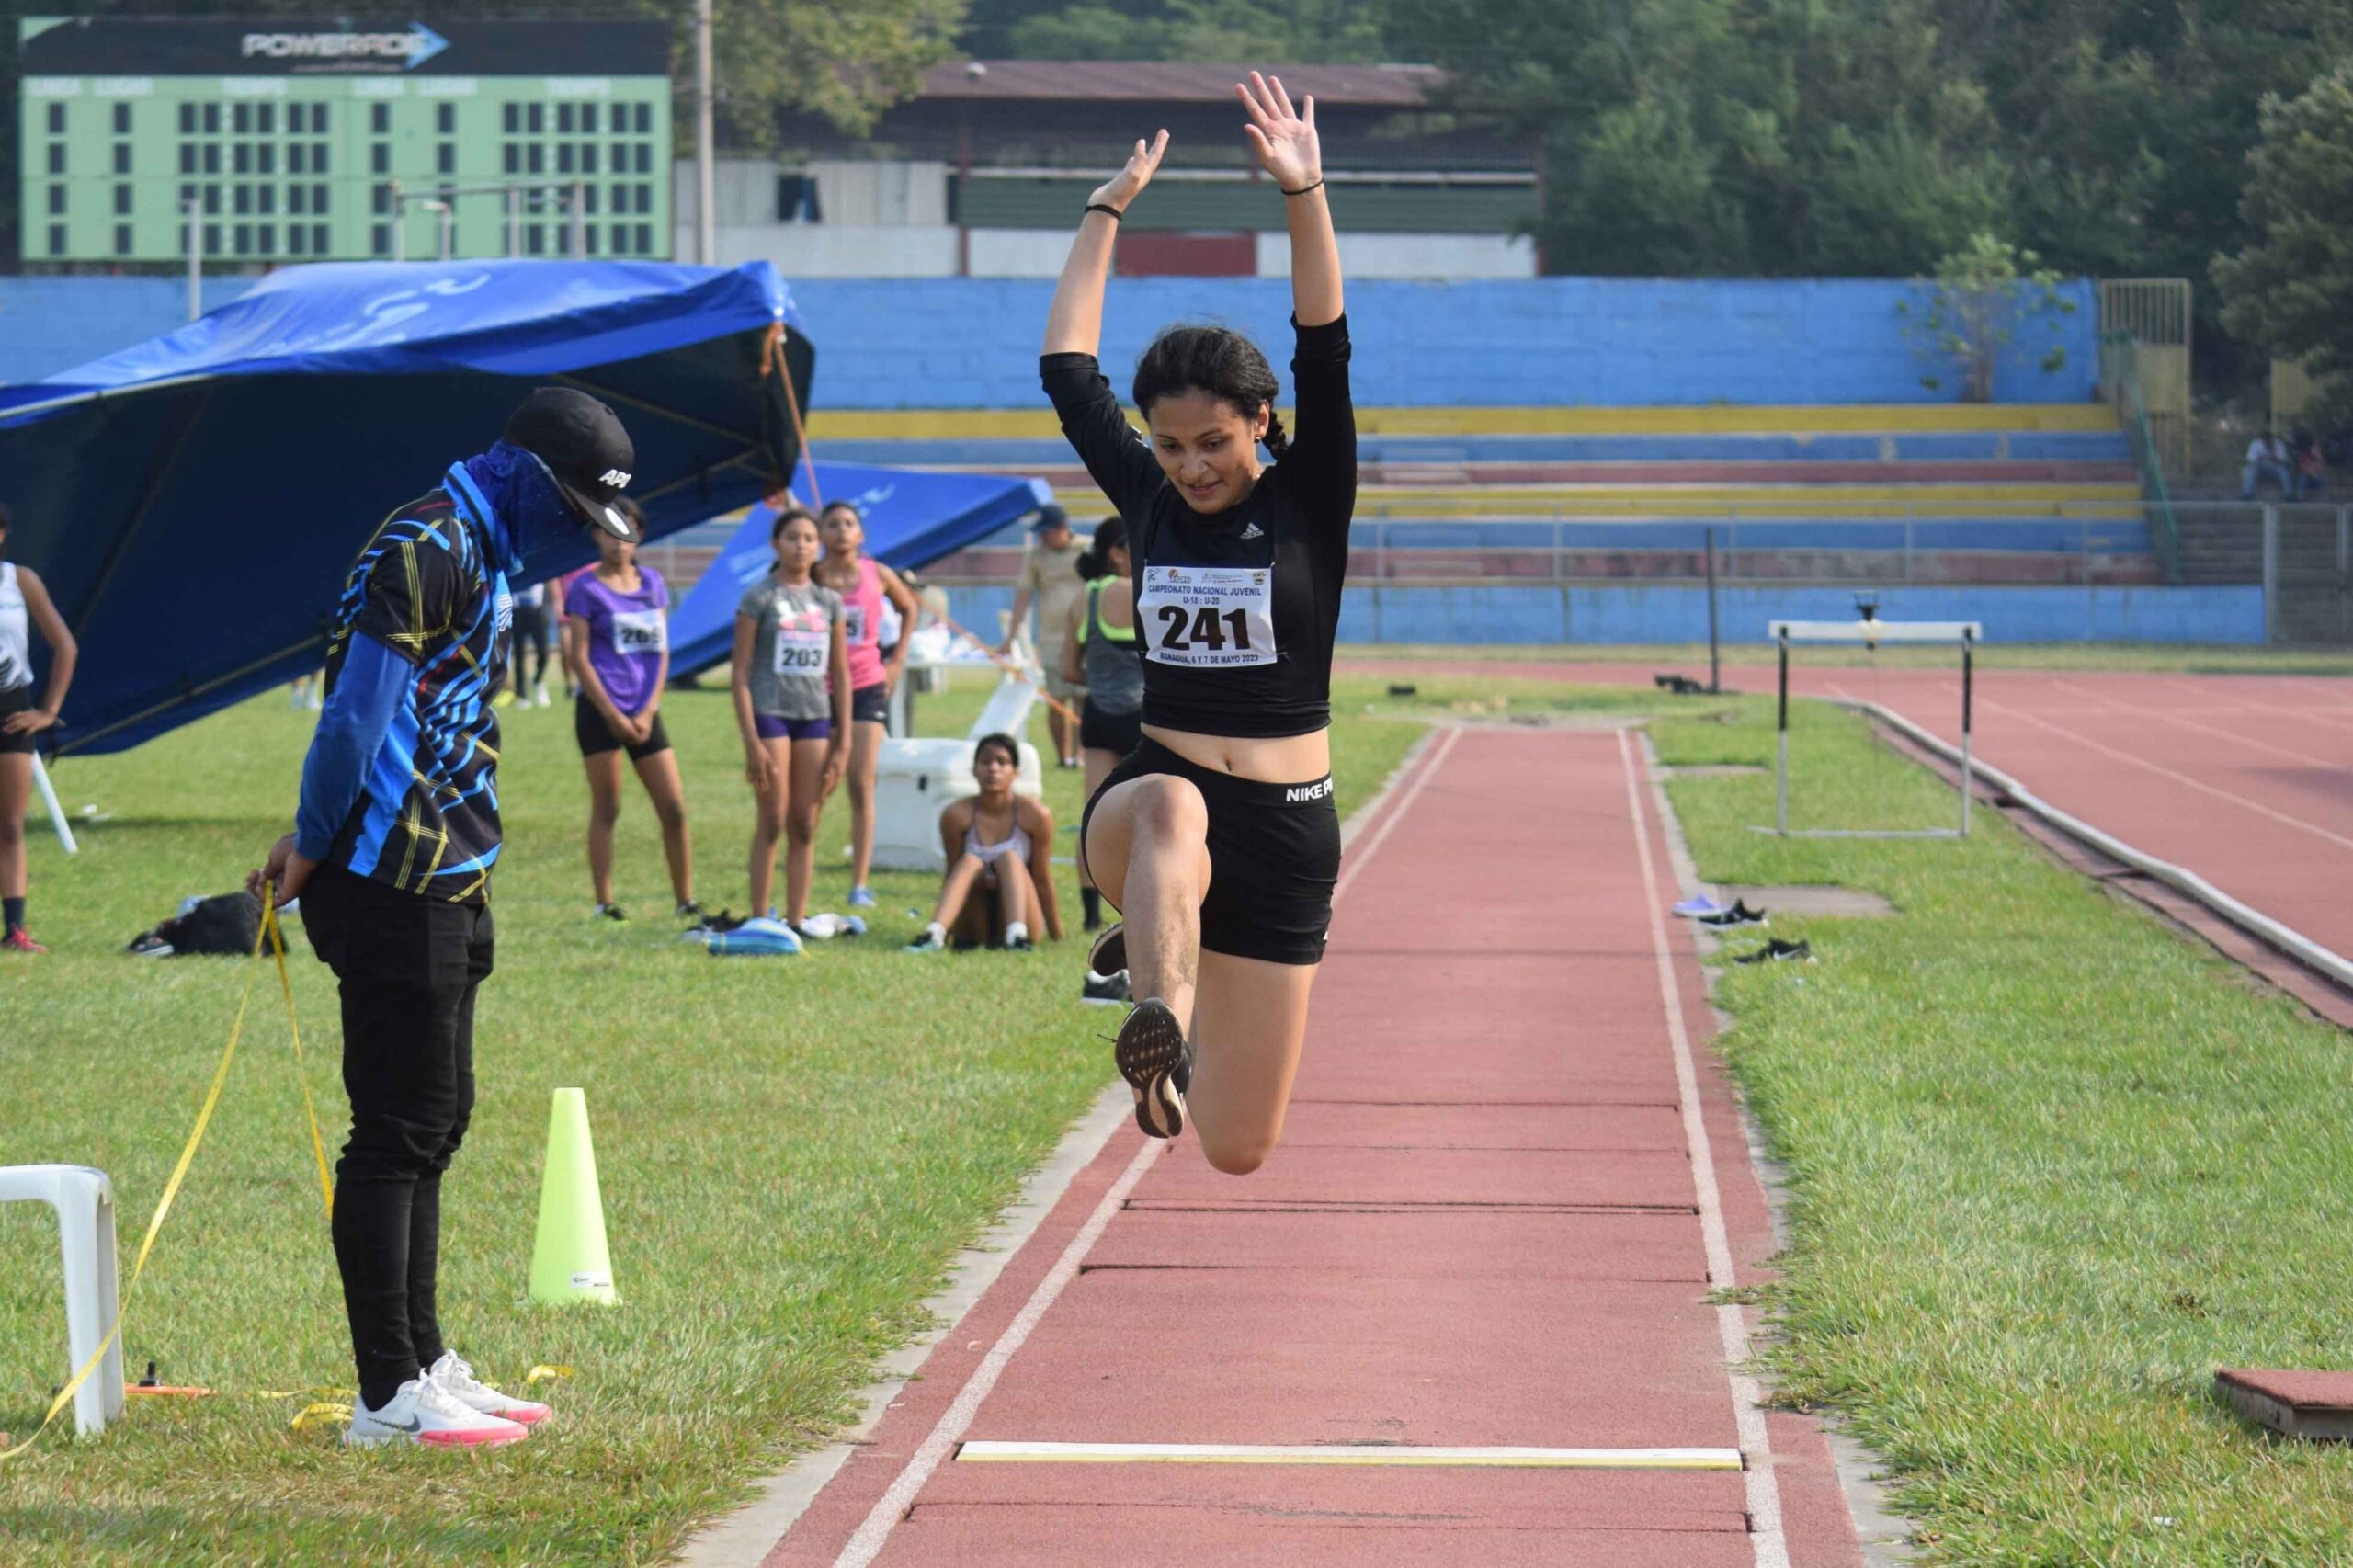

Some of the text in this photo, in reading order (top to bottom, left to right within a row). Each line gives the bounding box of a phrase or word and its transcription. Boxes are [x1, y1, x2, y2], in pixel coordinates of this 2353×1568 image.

[1149, 585, 1262, 596] CAMPEONATO NACIONAL JUVENIL
[1204, 597, 1220, 605] U-20
[1159, 605, 1251, 651] 241
[782, 647, 823, 666] 203
[1160, 652, 1191, 664] MANAGUA,
[1198, 655, 1203, 664] Y
[1210, 655, 1220, 664] DE
[1221, 654, 1240, 663] MAYO
[1242, 653, 1259, 662] 2023
[1286, 783, 1324, 802] NIKE
